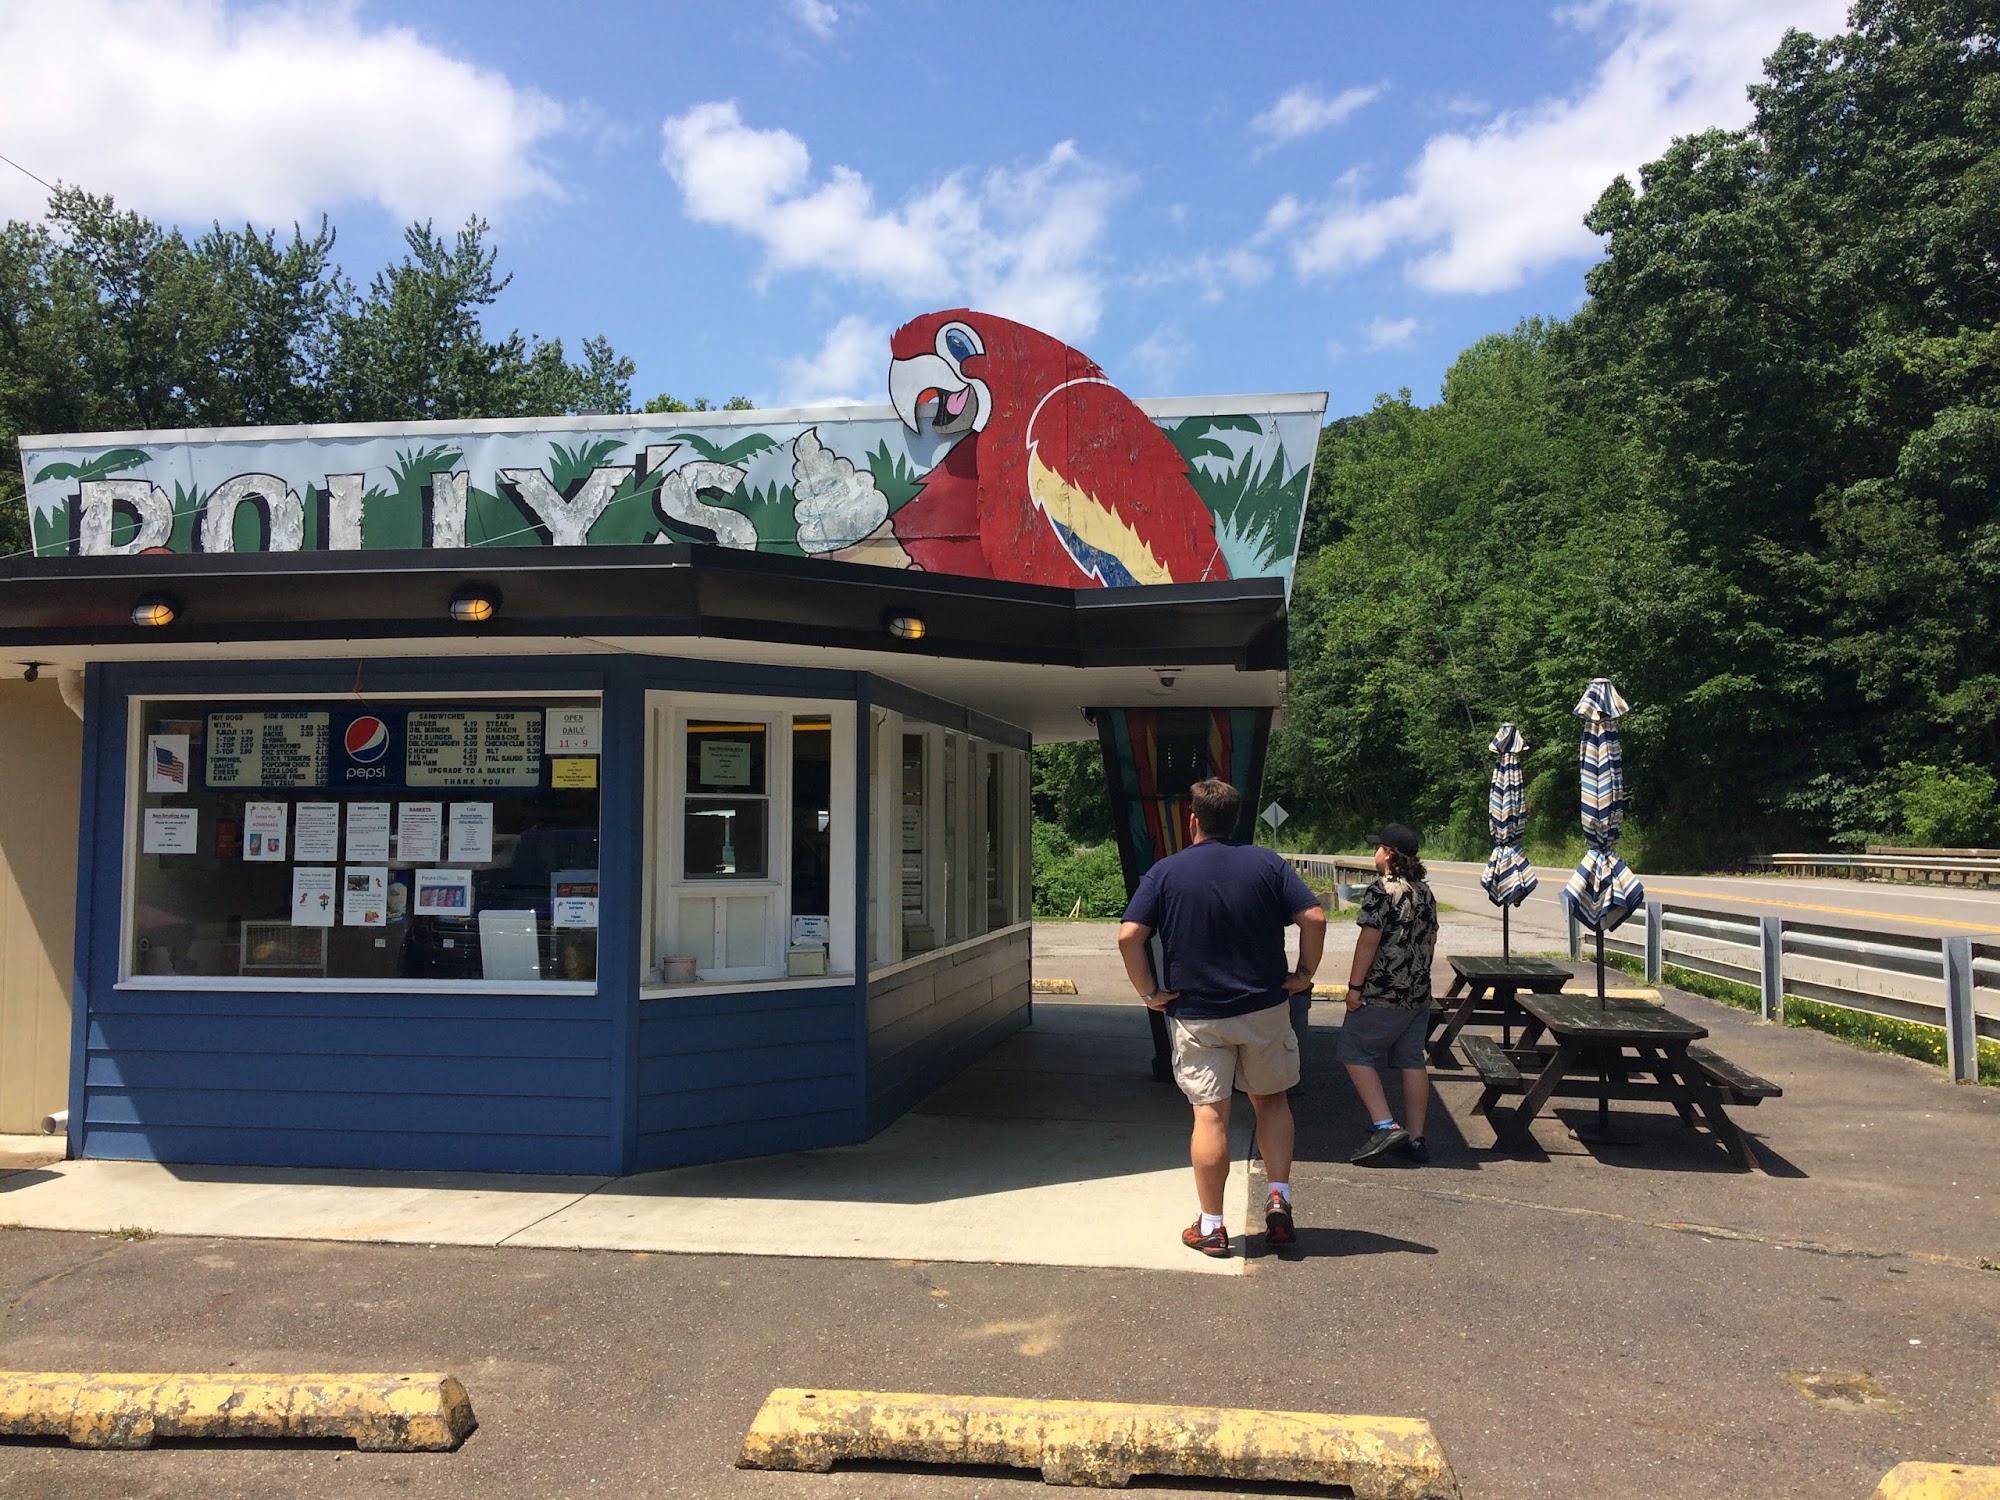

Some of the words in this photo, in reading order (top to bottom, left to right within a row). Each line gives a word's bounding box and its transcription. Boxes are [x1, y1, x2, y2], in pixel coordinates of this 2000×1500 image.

[78, 443, 759, 556] POLLY'S
[562, 726, 586, 734] DAILY
[560, 740, 569, 748] 11
[582, 740, 588, 748] 9
[346, 765, 386, 780] pepsi
